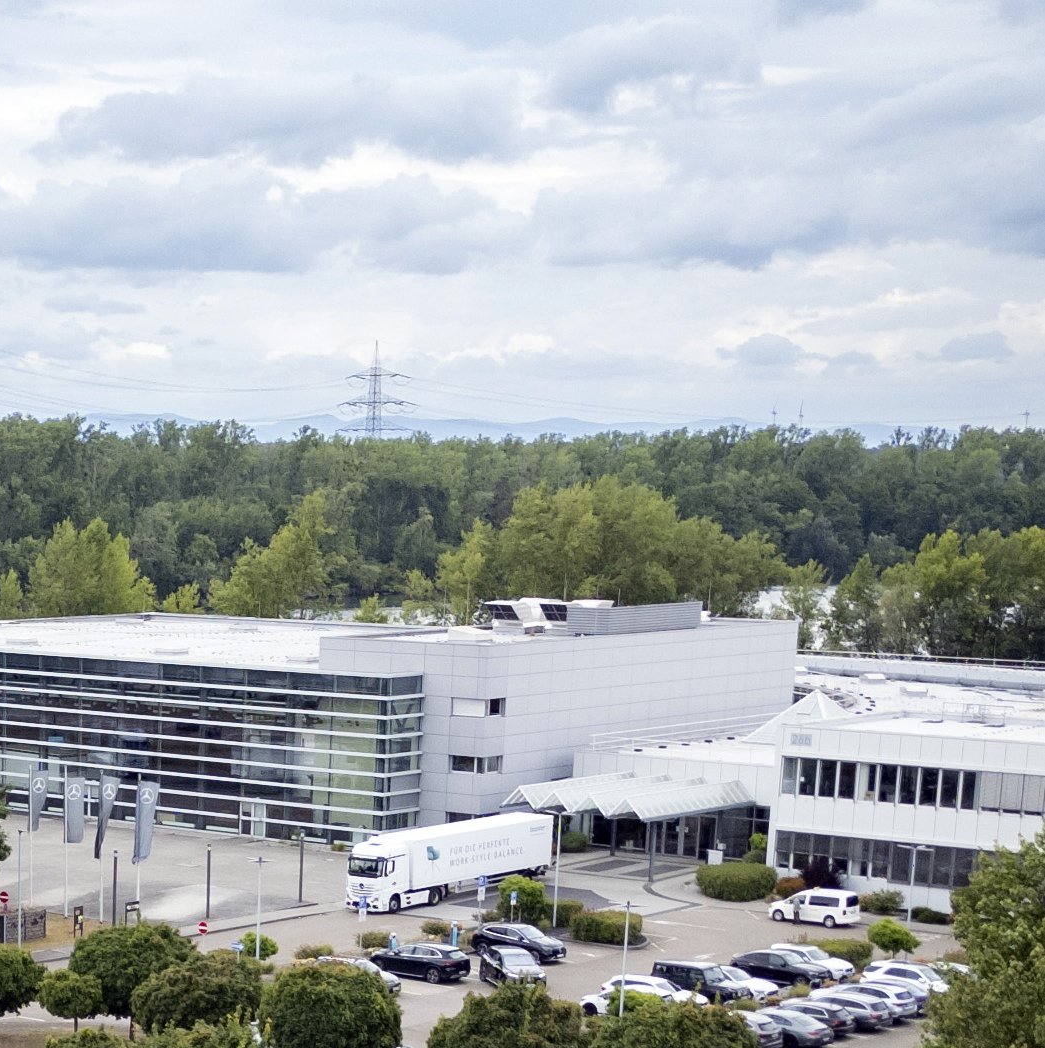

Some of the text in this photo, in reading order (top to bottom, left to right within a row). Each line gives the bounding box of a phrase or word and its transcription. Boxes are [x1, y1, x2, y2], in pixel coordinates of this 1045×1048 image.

[465, 844, 476, 853] DIE
[478, 838, 510, 850] PERFEKTE
[494, 846, 523, 858] BALANCE
